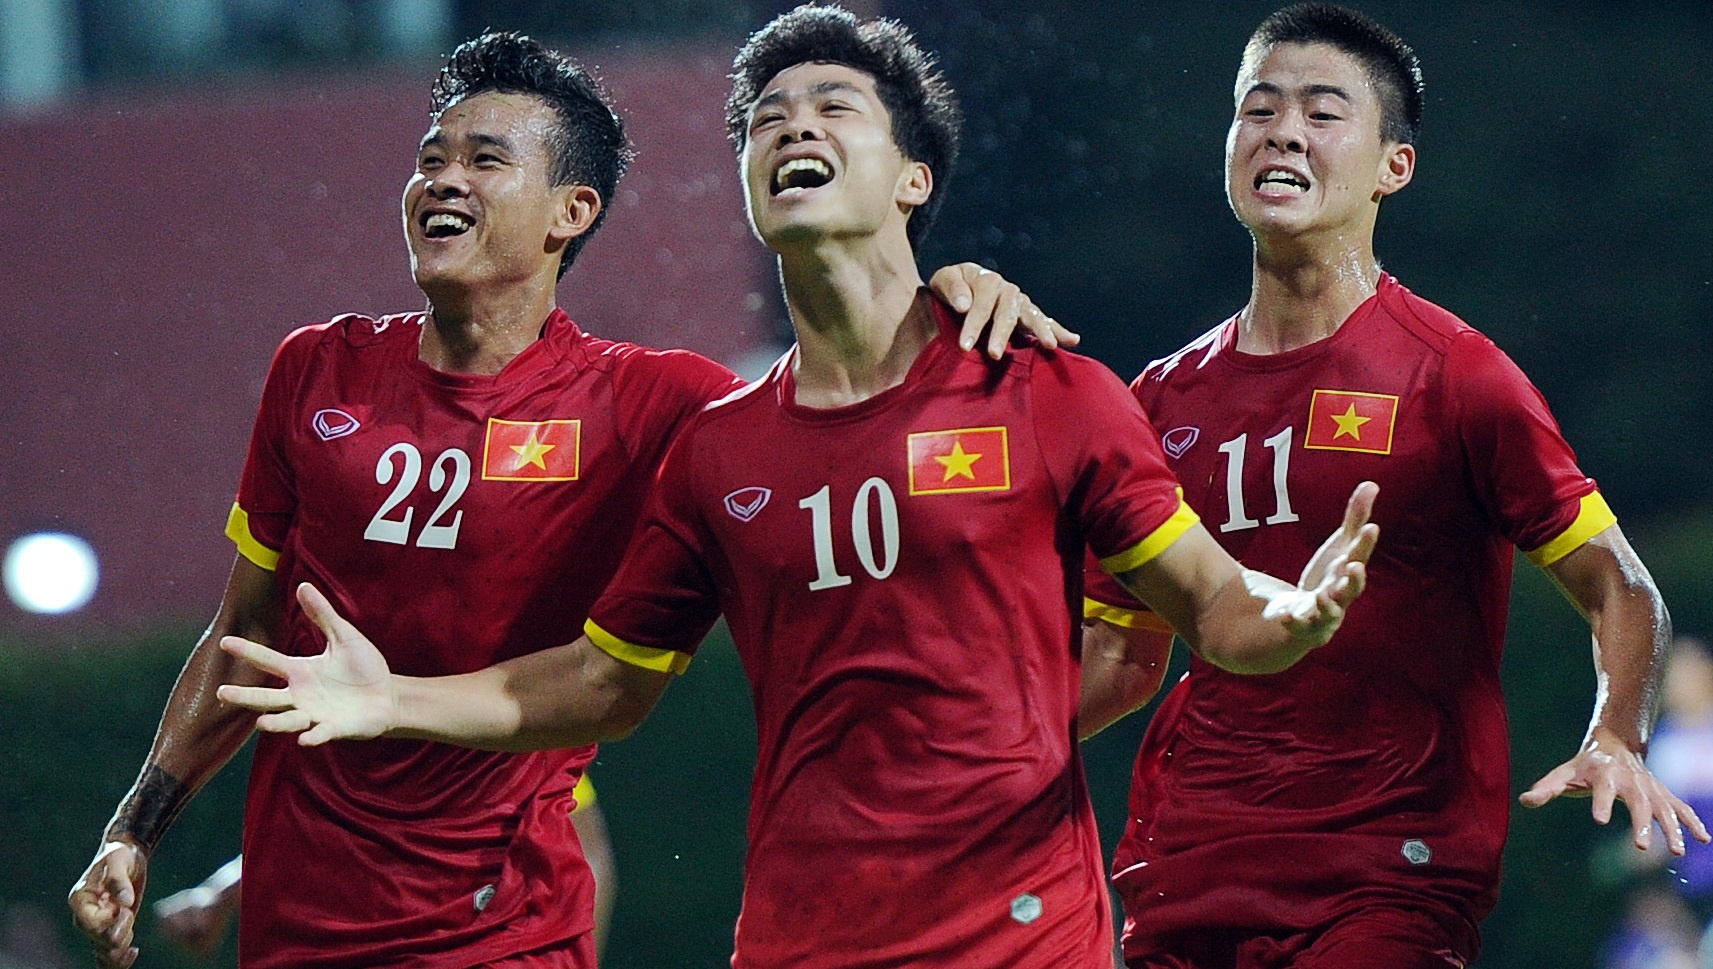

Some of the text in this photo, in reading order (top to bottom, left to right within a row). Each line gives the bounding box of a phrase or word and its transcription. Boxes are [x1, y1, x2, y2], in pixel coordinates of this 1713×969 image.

[363, 442, 471, 550] 22
[798, 476, 900, 591] 10
[1217, 426, 1301, 533] 11
